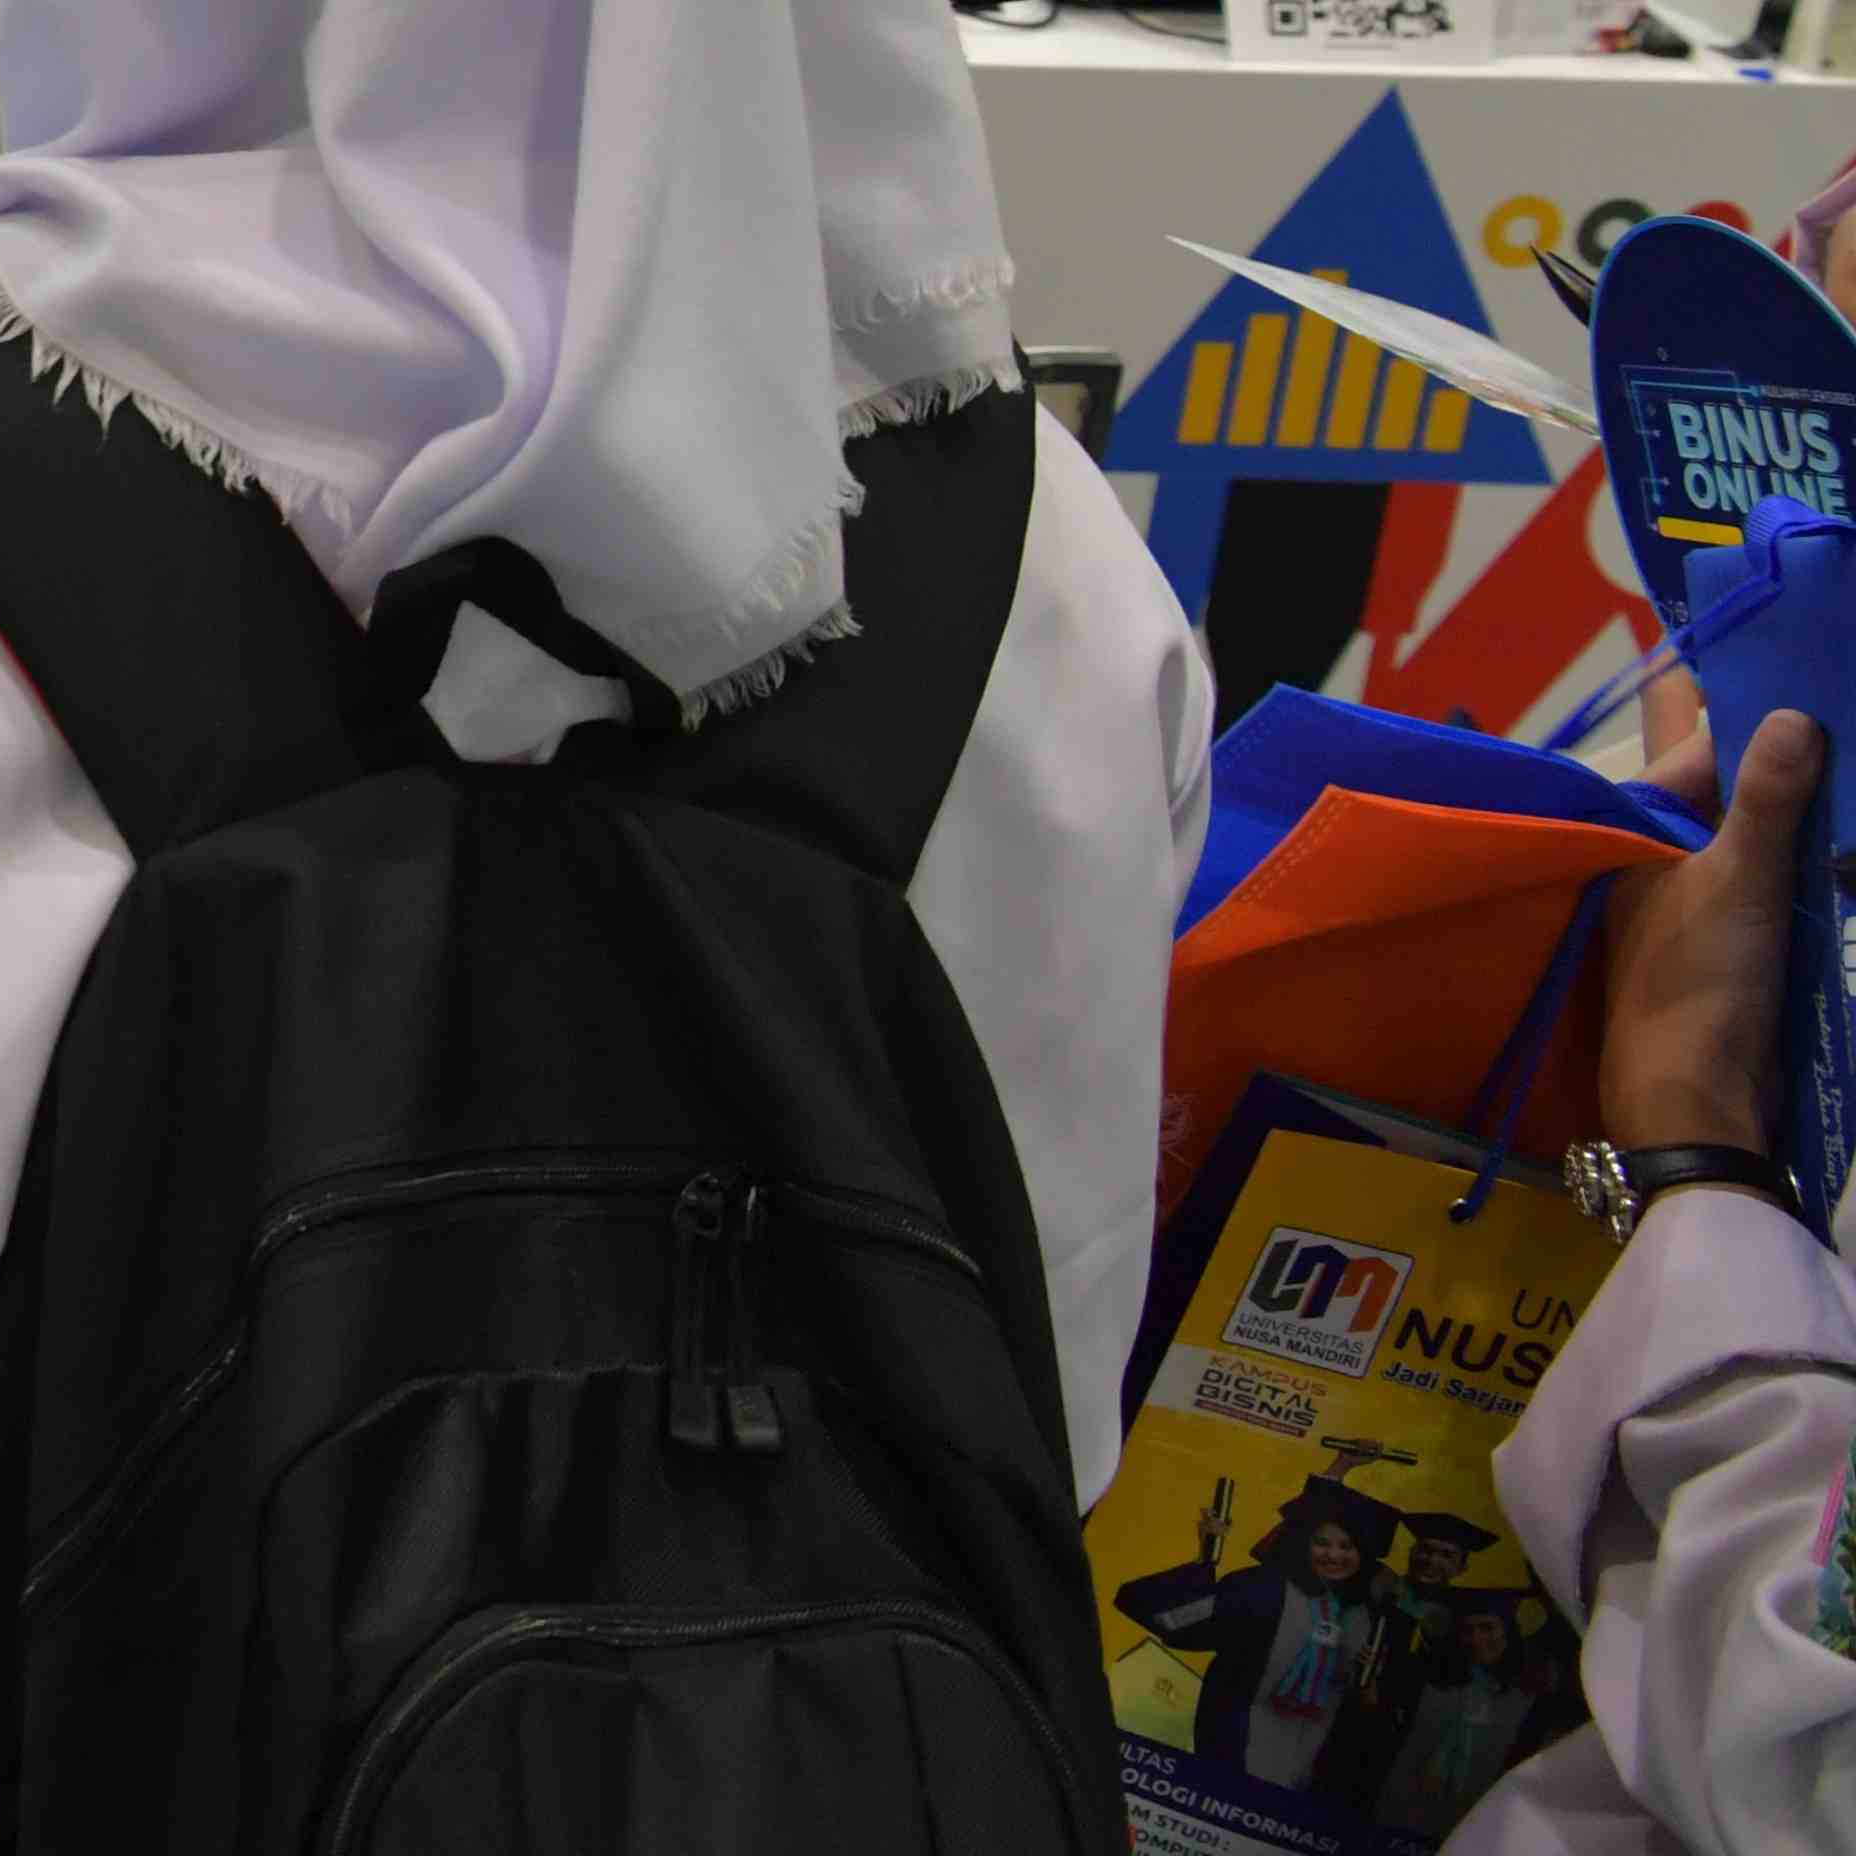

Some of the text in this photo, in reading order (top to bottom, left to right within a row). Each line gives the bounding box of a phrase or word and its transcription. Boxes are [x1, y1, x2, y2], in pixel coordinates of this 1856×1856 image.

[1667, 399, 1841, 474] BINUS
[1233, 1325, 1362, 1370] NUSA MANDIRI
[1239, 1311, 1365, 1354] UNIVERSITAS
[1201, 1367, 1320, 1414] DIGITAL
[1383, 1361, 1441, 1392] Jadi
[1195, 1384, 1316, 1428] BISNIS
[1119, 1742, 1177, 1776] LTAS
[1155, 1813, 1220, 1847] STUDI
[1200, 1795, 1340, 1853] INFORMASI
